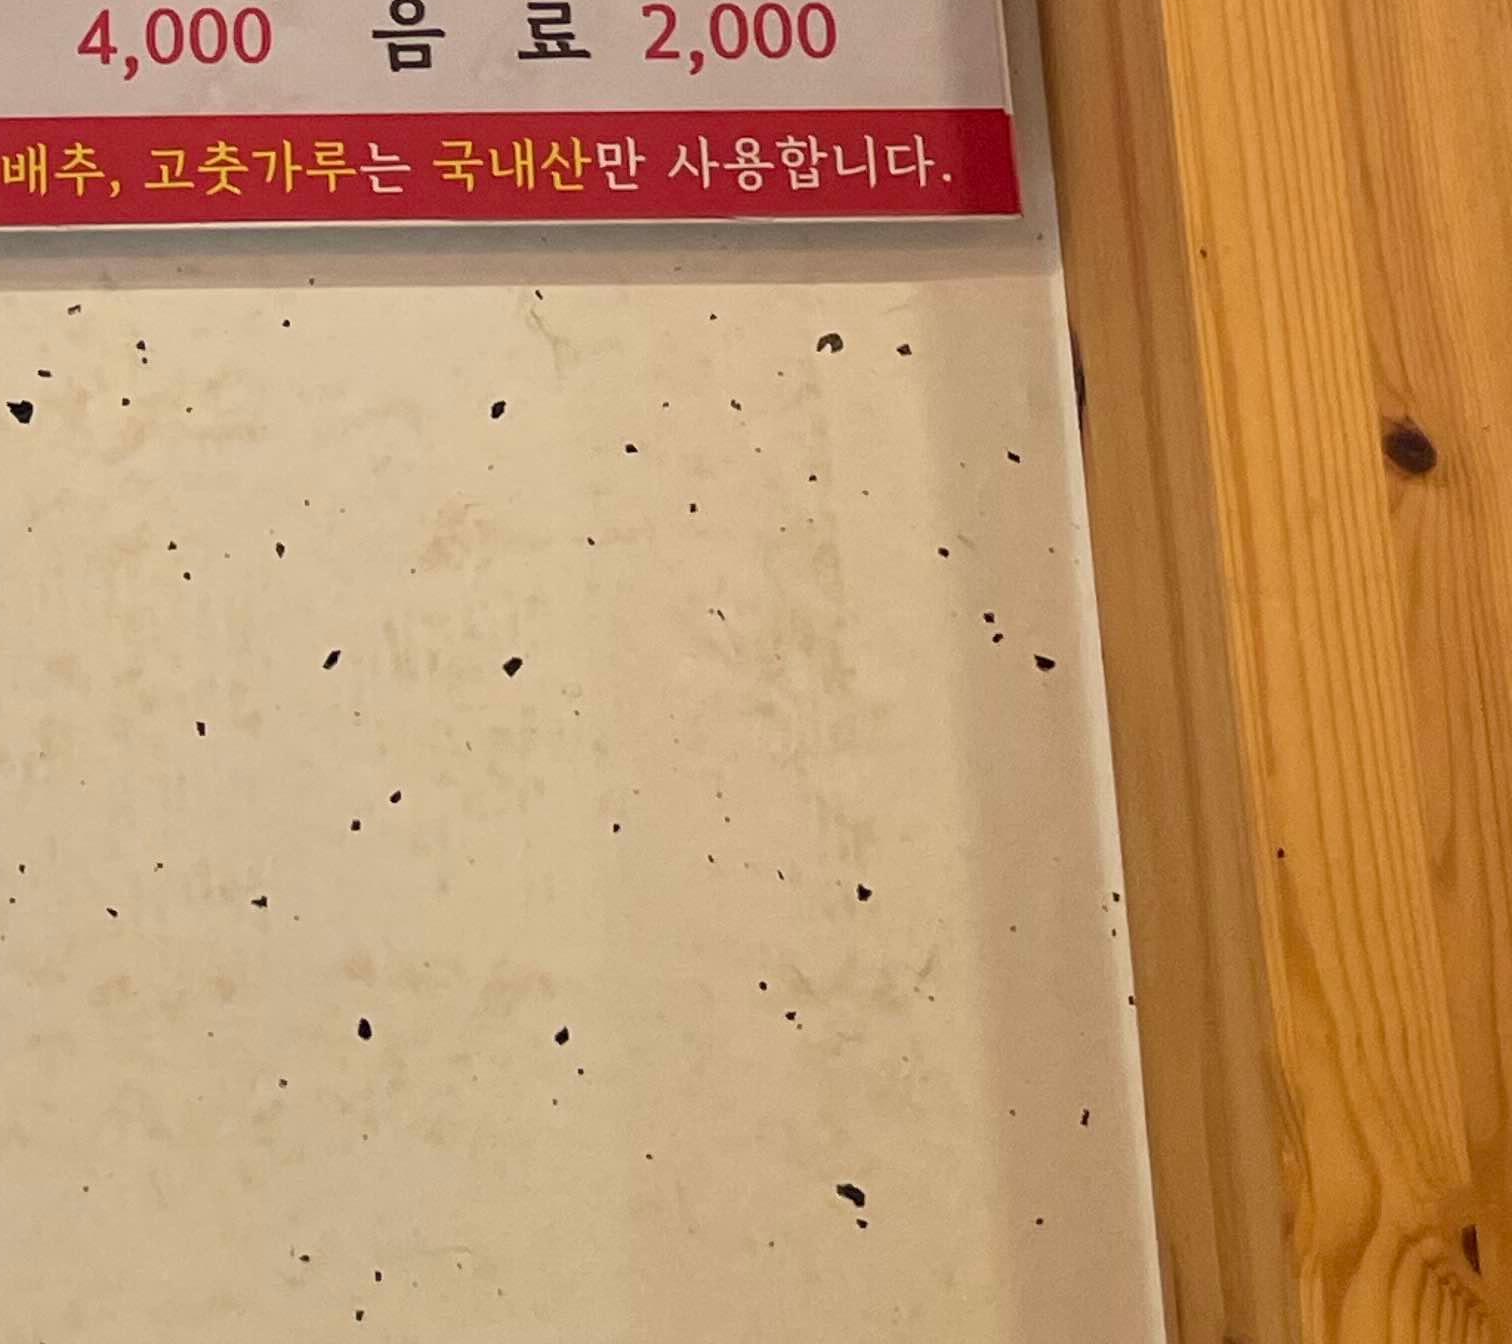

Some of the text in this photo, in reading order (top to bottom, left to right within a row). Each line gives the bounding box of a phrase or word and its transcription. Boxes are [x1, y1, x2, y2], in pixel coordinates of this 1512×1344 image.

[78, 8, 271, 80] 4,000
[643, 3, 836, 75] 2,000
[2, 143, 120, 197] 배추,
[145, 140, 411, 194] 고춧가루는
[433, 137, 645, 192] 국내산만
[668, 135, 951, 191] 사용합니다.
